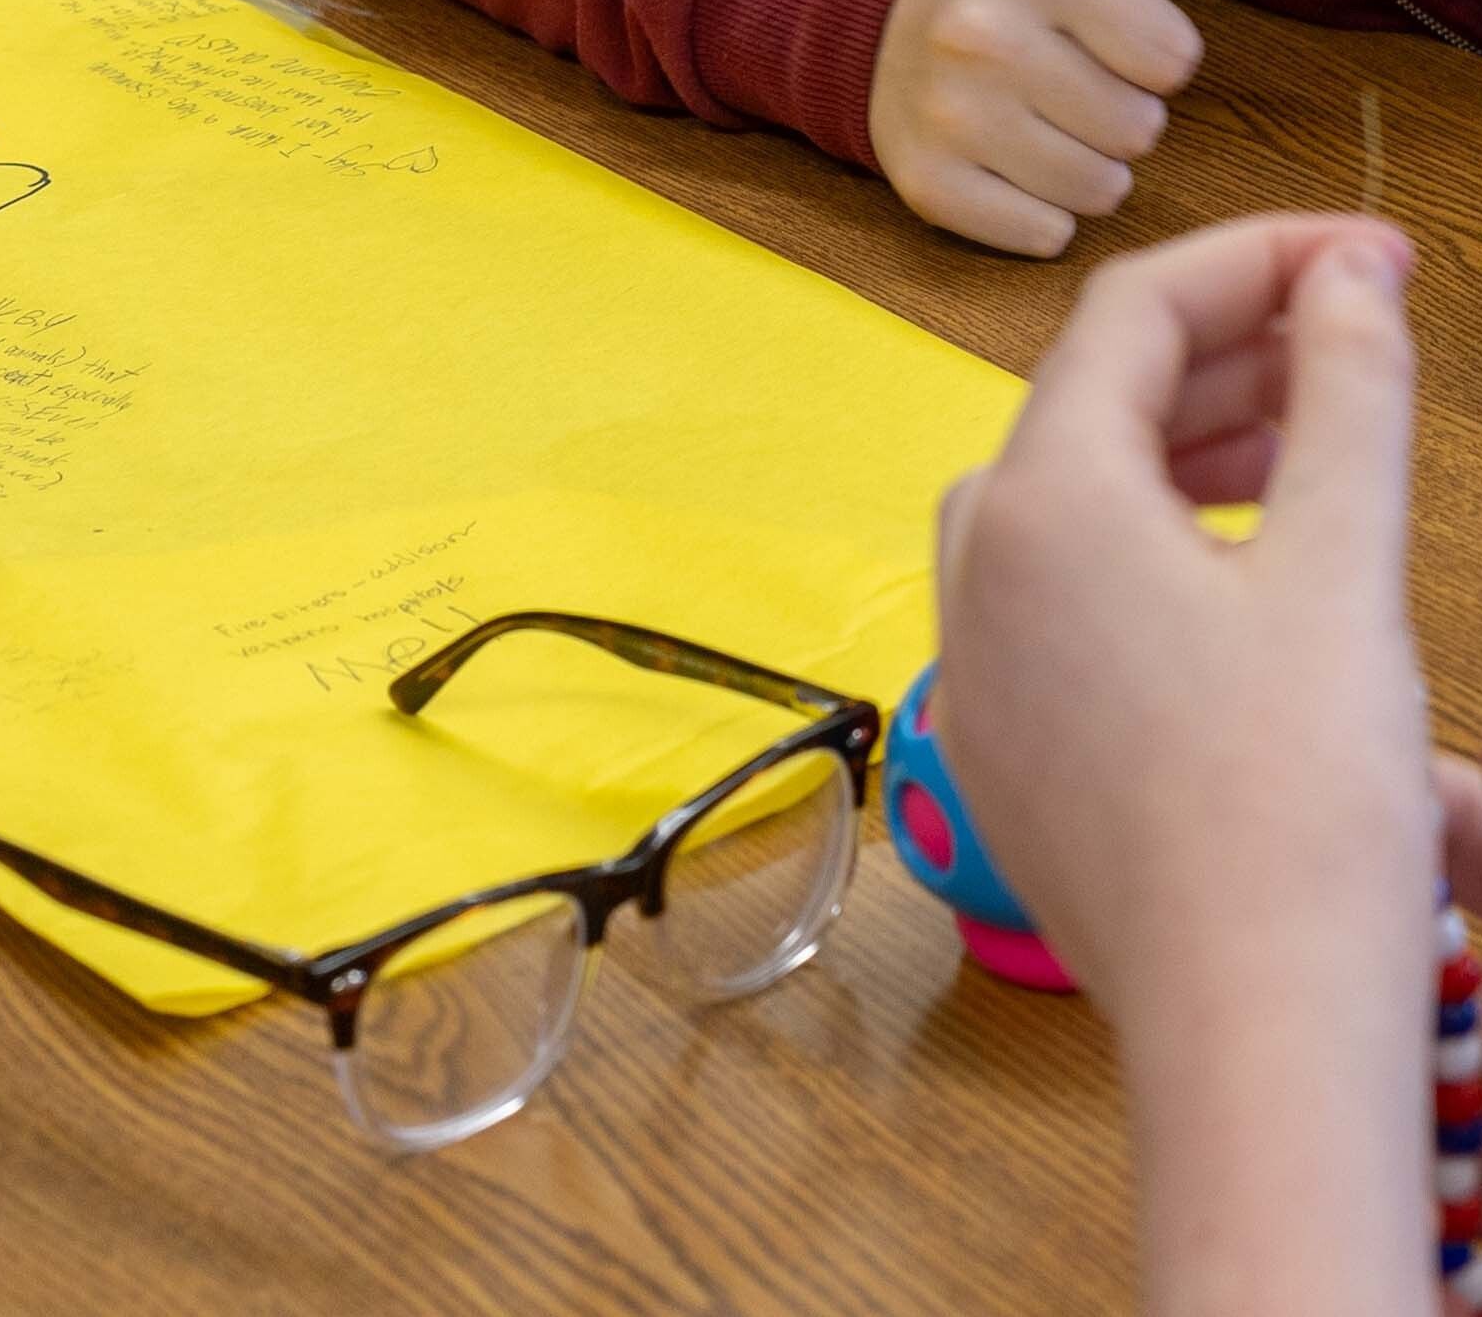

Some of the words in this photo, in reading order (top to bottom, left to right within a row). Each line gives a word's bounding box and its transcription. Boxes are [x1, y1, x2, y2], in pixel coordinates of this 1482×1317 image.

[270, 58, 402, 96] everyone
[227, 125, 285, 150] think
[293, 117, 342, 139] that
[326, 143, 374, 177] Sky
[78, 358, 152, 384] that
